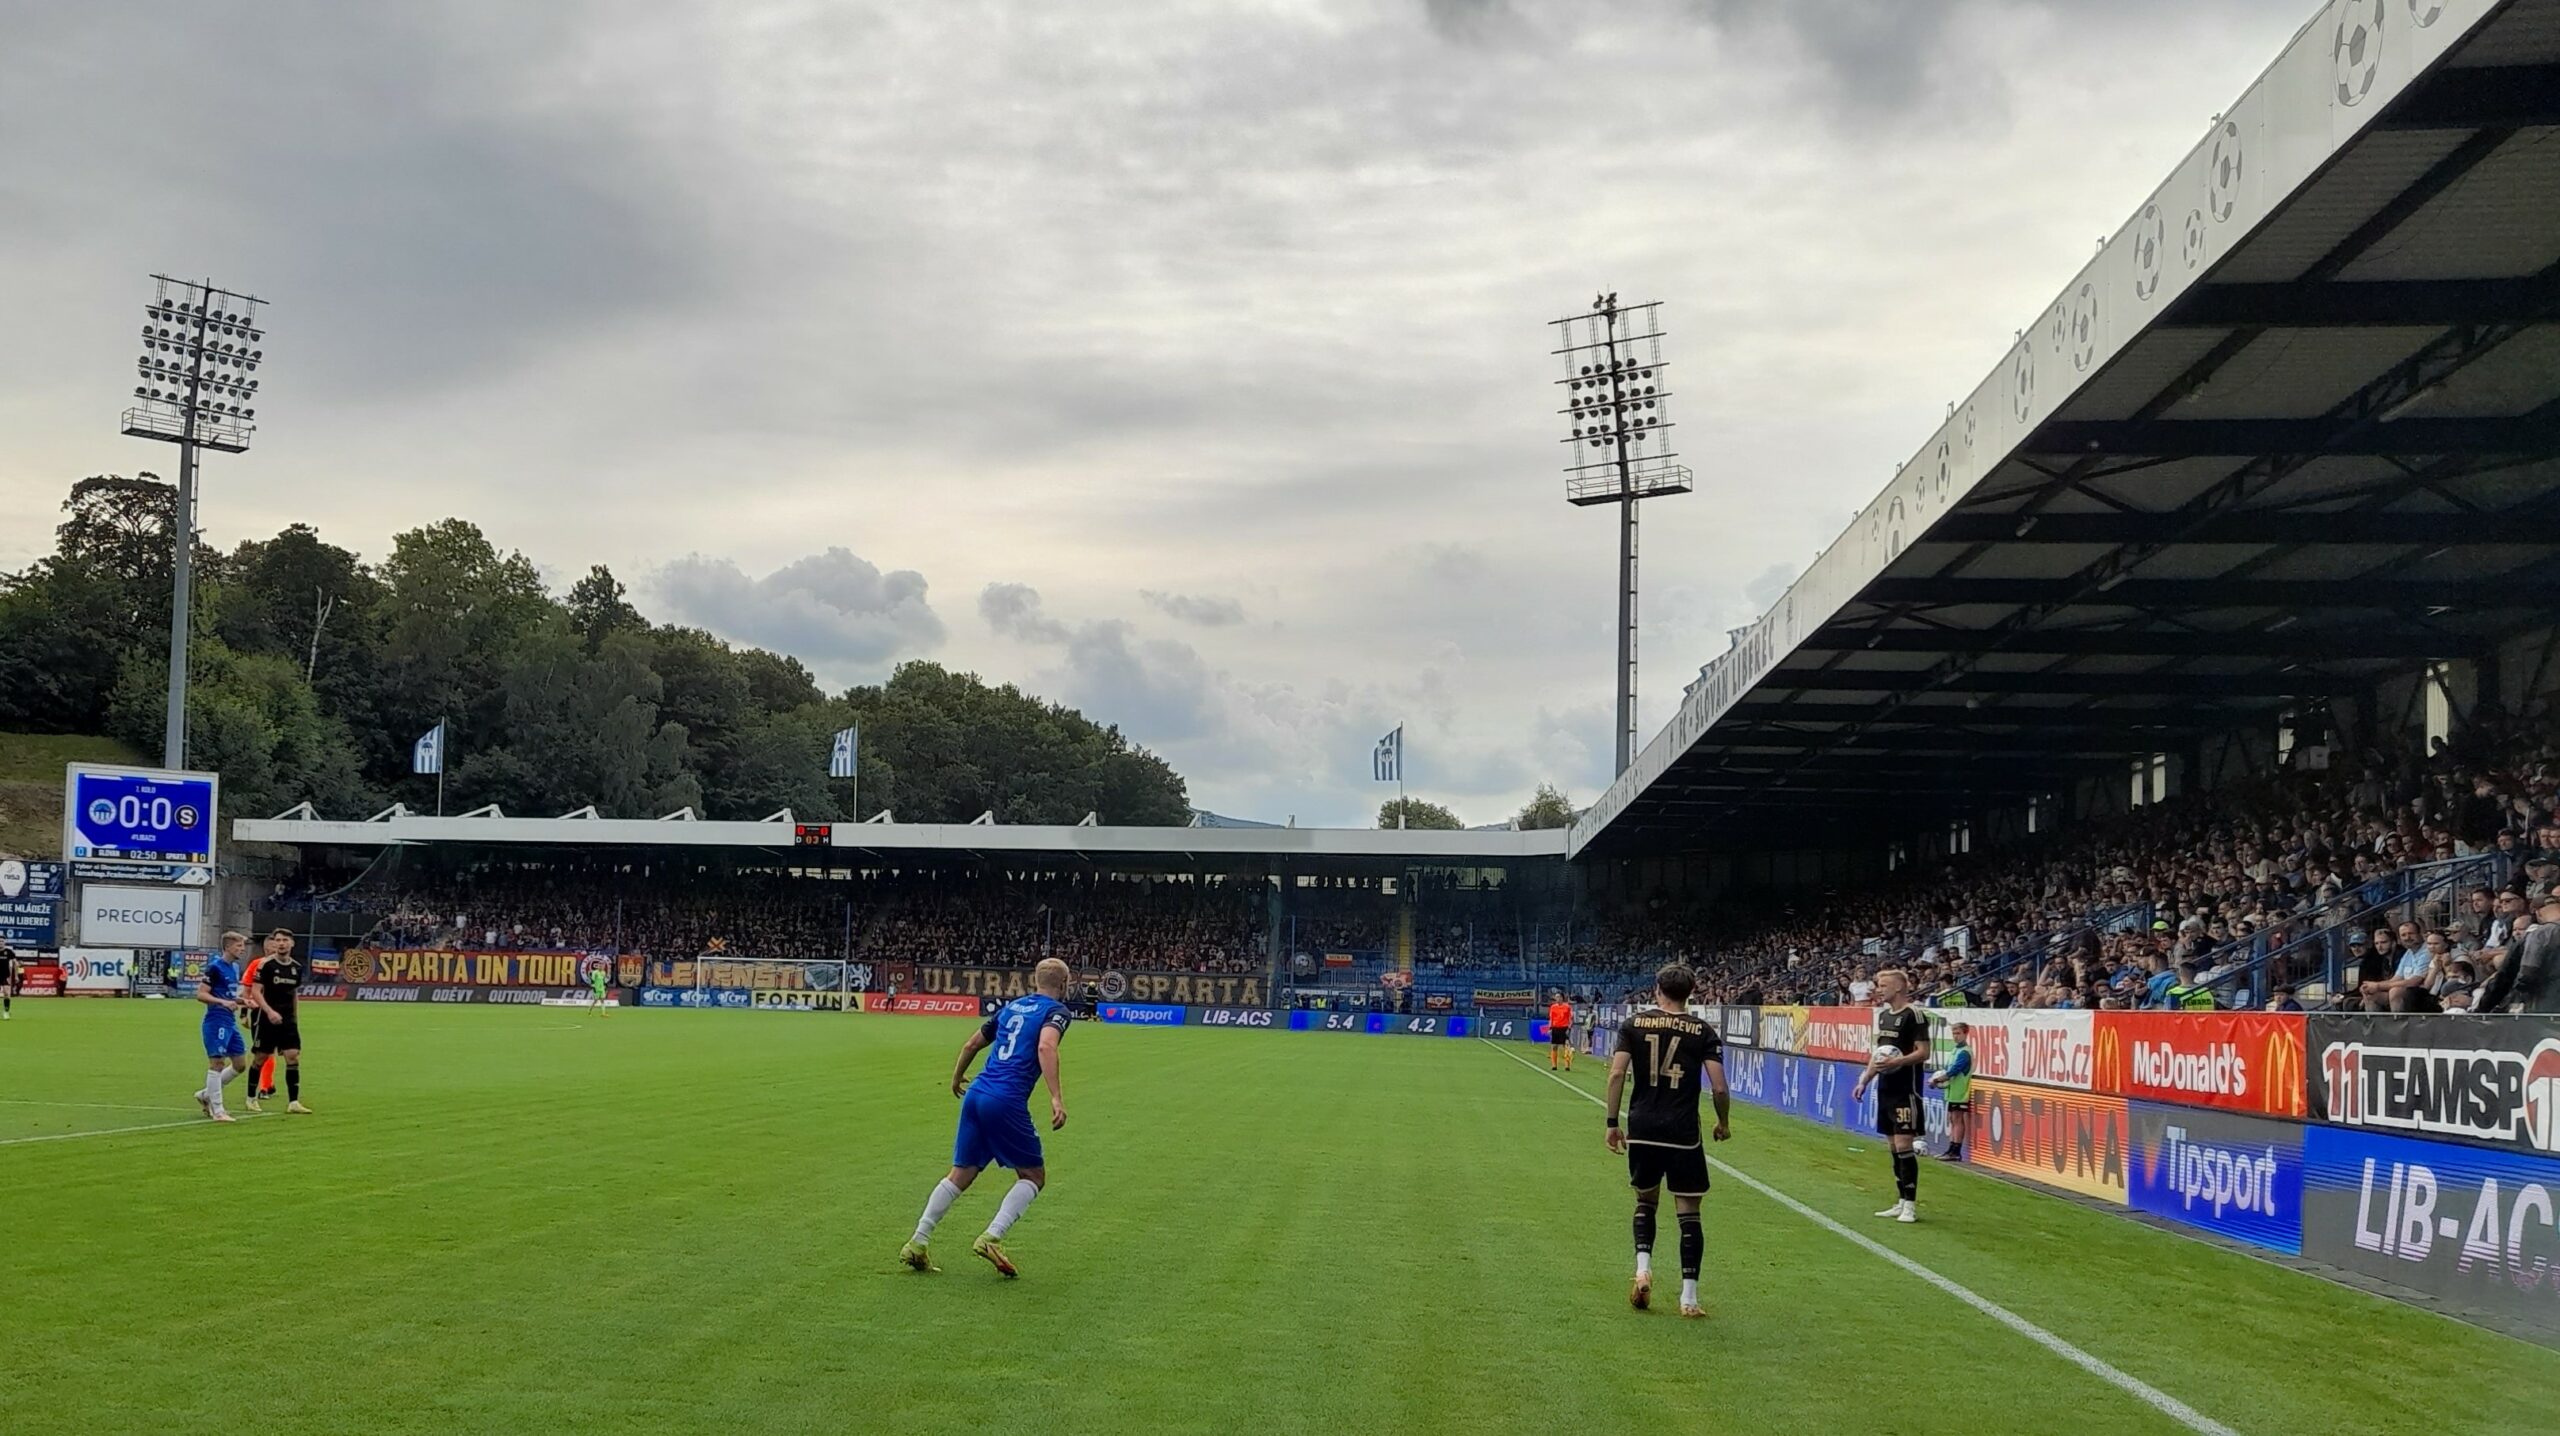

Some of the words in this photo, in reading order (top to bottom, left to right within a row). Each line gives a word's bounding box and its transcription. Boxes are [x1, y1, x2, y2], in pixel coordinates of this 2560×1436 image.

[1695, 667, 1728, 733] SLOVAN
[1732, 616, 1775, 697] LIBEREC
[119, 795, 172, 830] 0:0
[130, 850, 157, 860] 02:50
[165, 853, 187, 861] SPARTA
[16, 916, 50, 926] LIBEREC
[96, 907, 185, 926] PRECIOSA
[377, 952, 469, 984] SPARTA
[475, 954, 509, 985] ON
[516, 954, 577, 987] TOUR
[356, 985, 420, 1001] PRACOVNÍ
[432, 985, 474, 1002] ODĚVY
[488, 988, 547, 1003] OUTDOOR
[755, 992, 860, 1011] FORTUNA
[1131, 974, 1261, 1006] SPARTA
[1119, 1006, 1173, 1025] Tipsport
[1201, 1008, 1273, 1027] LIB-ACS
[1326, 1013, 1355, 1030] 5.4
[1408, 1017, 1437, 1034] 4.2
[1488, 1020, 1513, 1036] 1.6
[218, 1027, 225, 1040] 8
[998, 1014, 1025, 1061] 3
[1764, 1014, 1795, 1052] IMPULS
[1838, 1023, 1872, 1053] TOSHIBA
[1644, 1033, 1685, 1090] 14
[2021, 1026, 2091, 1085] iDNES.cz
[2132, 1039, 2247, 1097] McDonald's
[1730, 1050, 1765, 1099] LIB-ACS
[1782, 1057, 1799, 1108] 5.4
[1815, 1063, 1836, 1119] 4.2
[1896, 1107, 1911, 1123] 30
[1970, 1089, 2126, 1190] FORTUNA
[2165, 1124, 2277, 1220] Tipsport
[2354, 1156, 2560, 1298] LIB-AC
